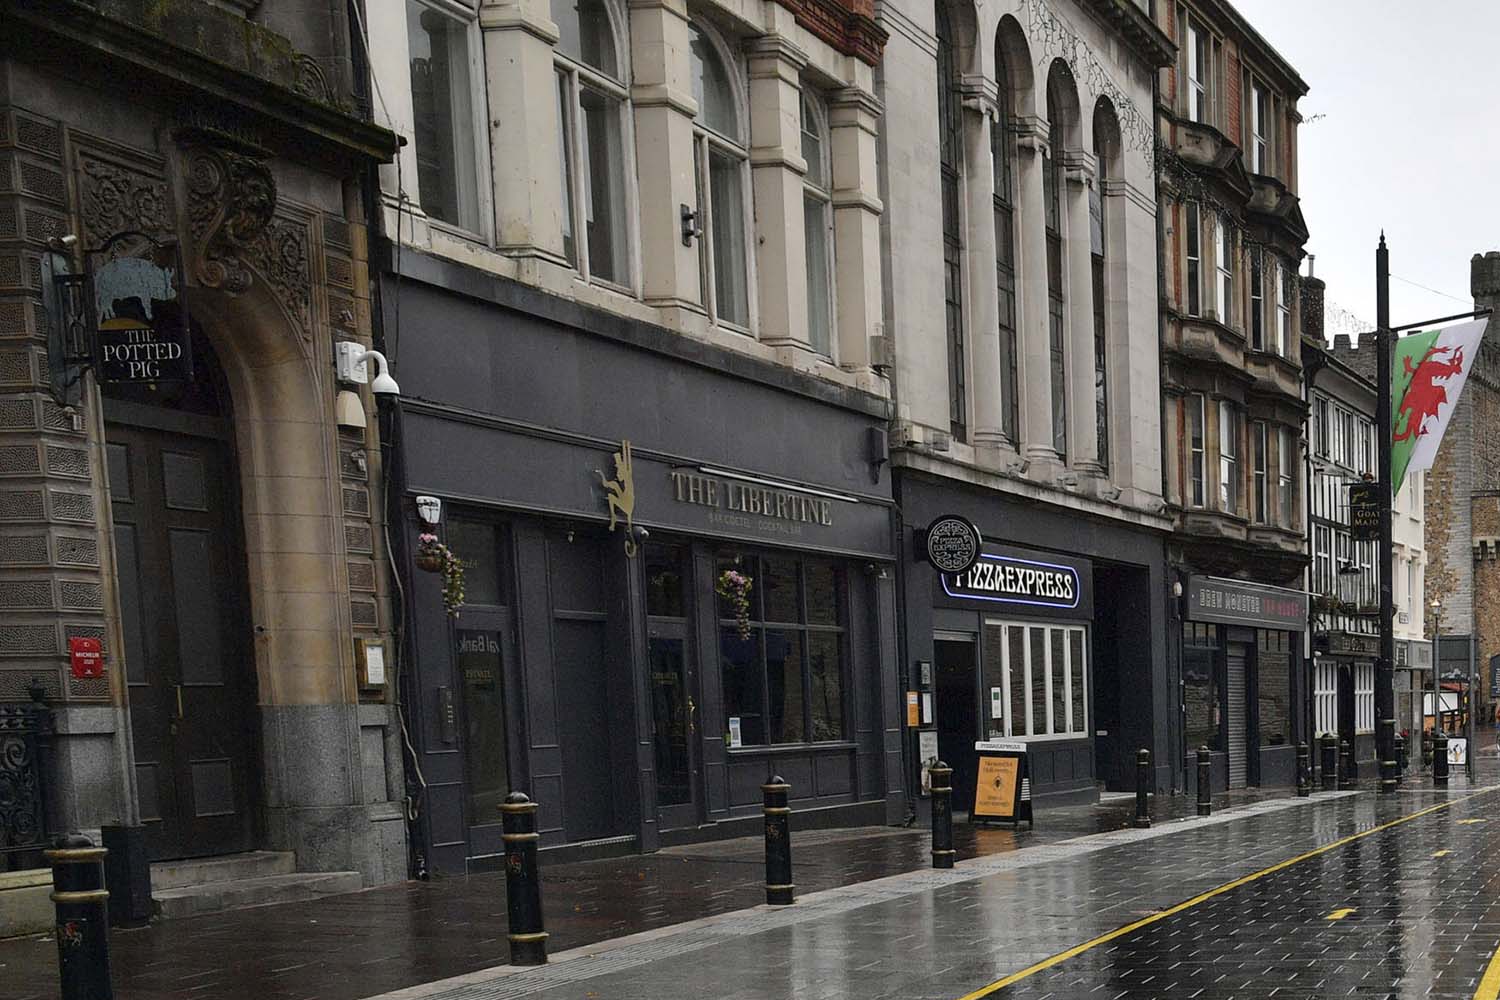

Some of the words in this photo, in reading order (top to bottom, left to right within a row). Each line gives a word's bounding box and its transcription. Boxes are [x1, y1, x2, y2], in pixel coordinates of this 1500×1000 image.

[125, 330, 155, 343] THE
[103, 342, 181, 361] POTTED
[128, 361, 160, 378] PIG
[671, 472, 720, 507] THE
[724, 482, 832, 526] LIBERTINE
[1354, 518, 1379, 527] MAJO
